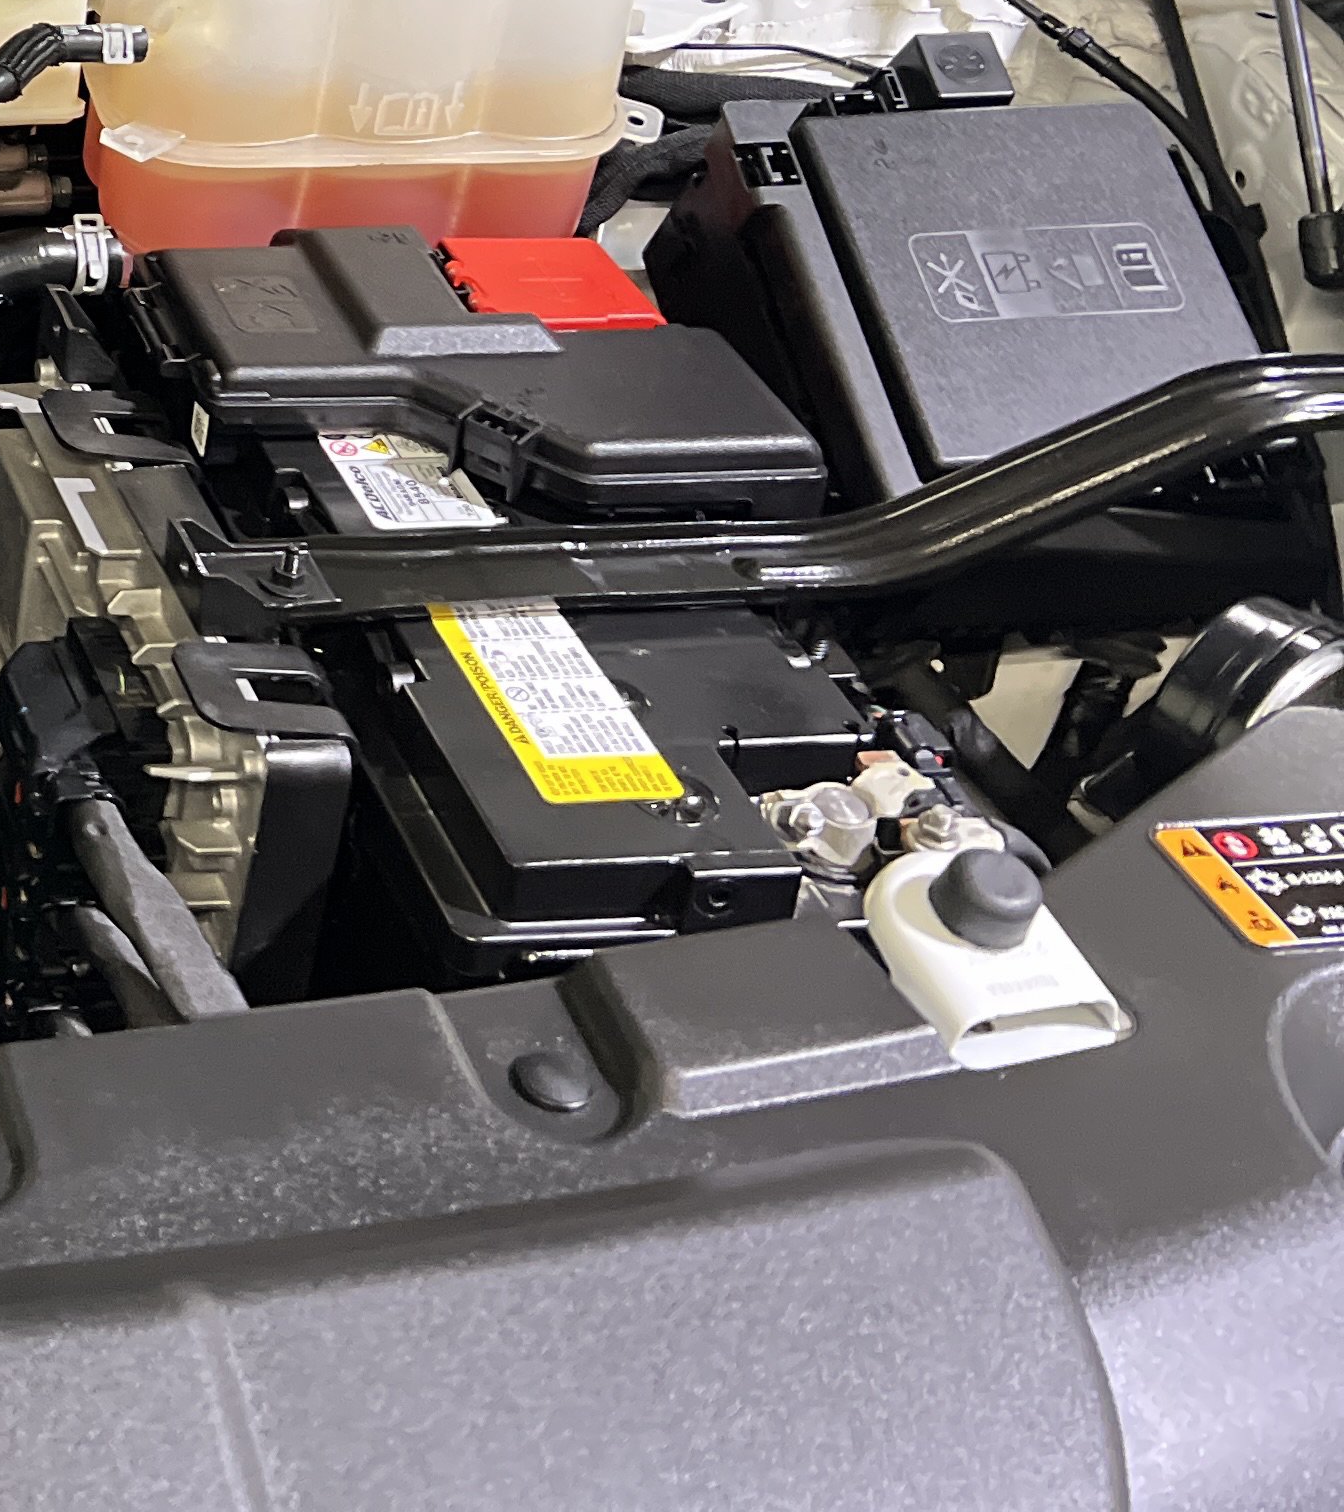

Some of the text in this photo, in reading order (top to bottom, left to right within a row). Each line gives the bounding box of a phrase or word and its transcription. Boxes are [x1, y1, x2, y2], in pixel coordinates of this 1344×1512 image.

[349, 465, 393, 520] ACDelco
[405, 479, 431, 505] 8540
[461, 653, 523, 734] DANGER/POISON
